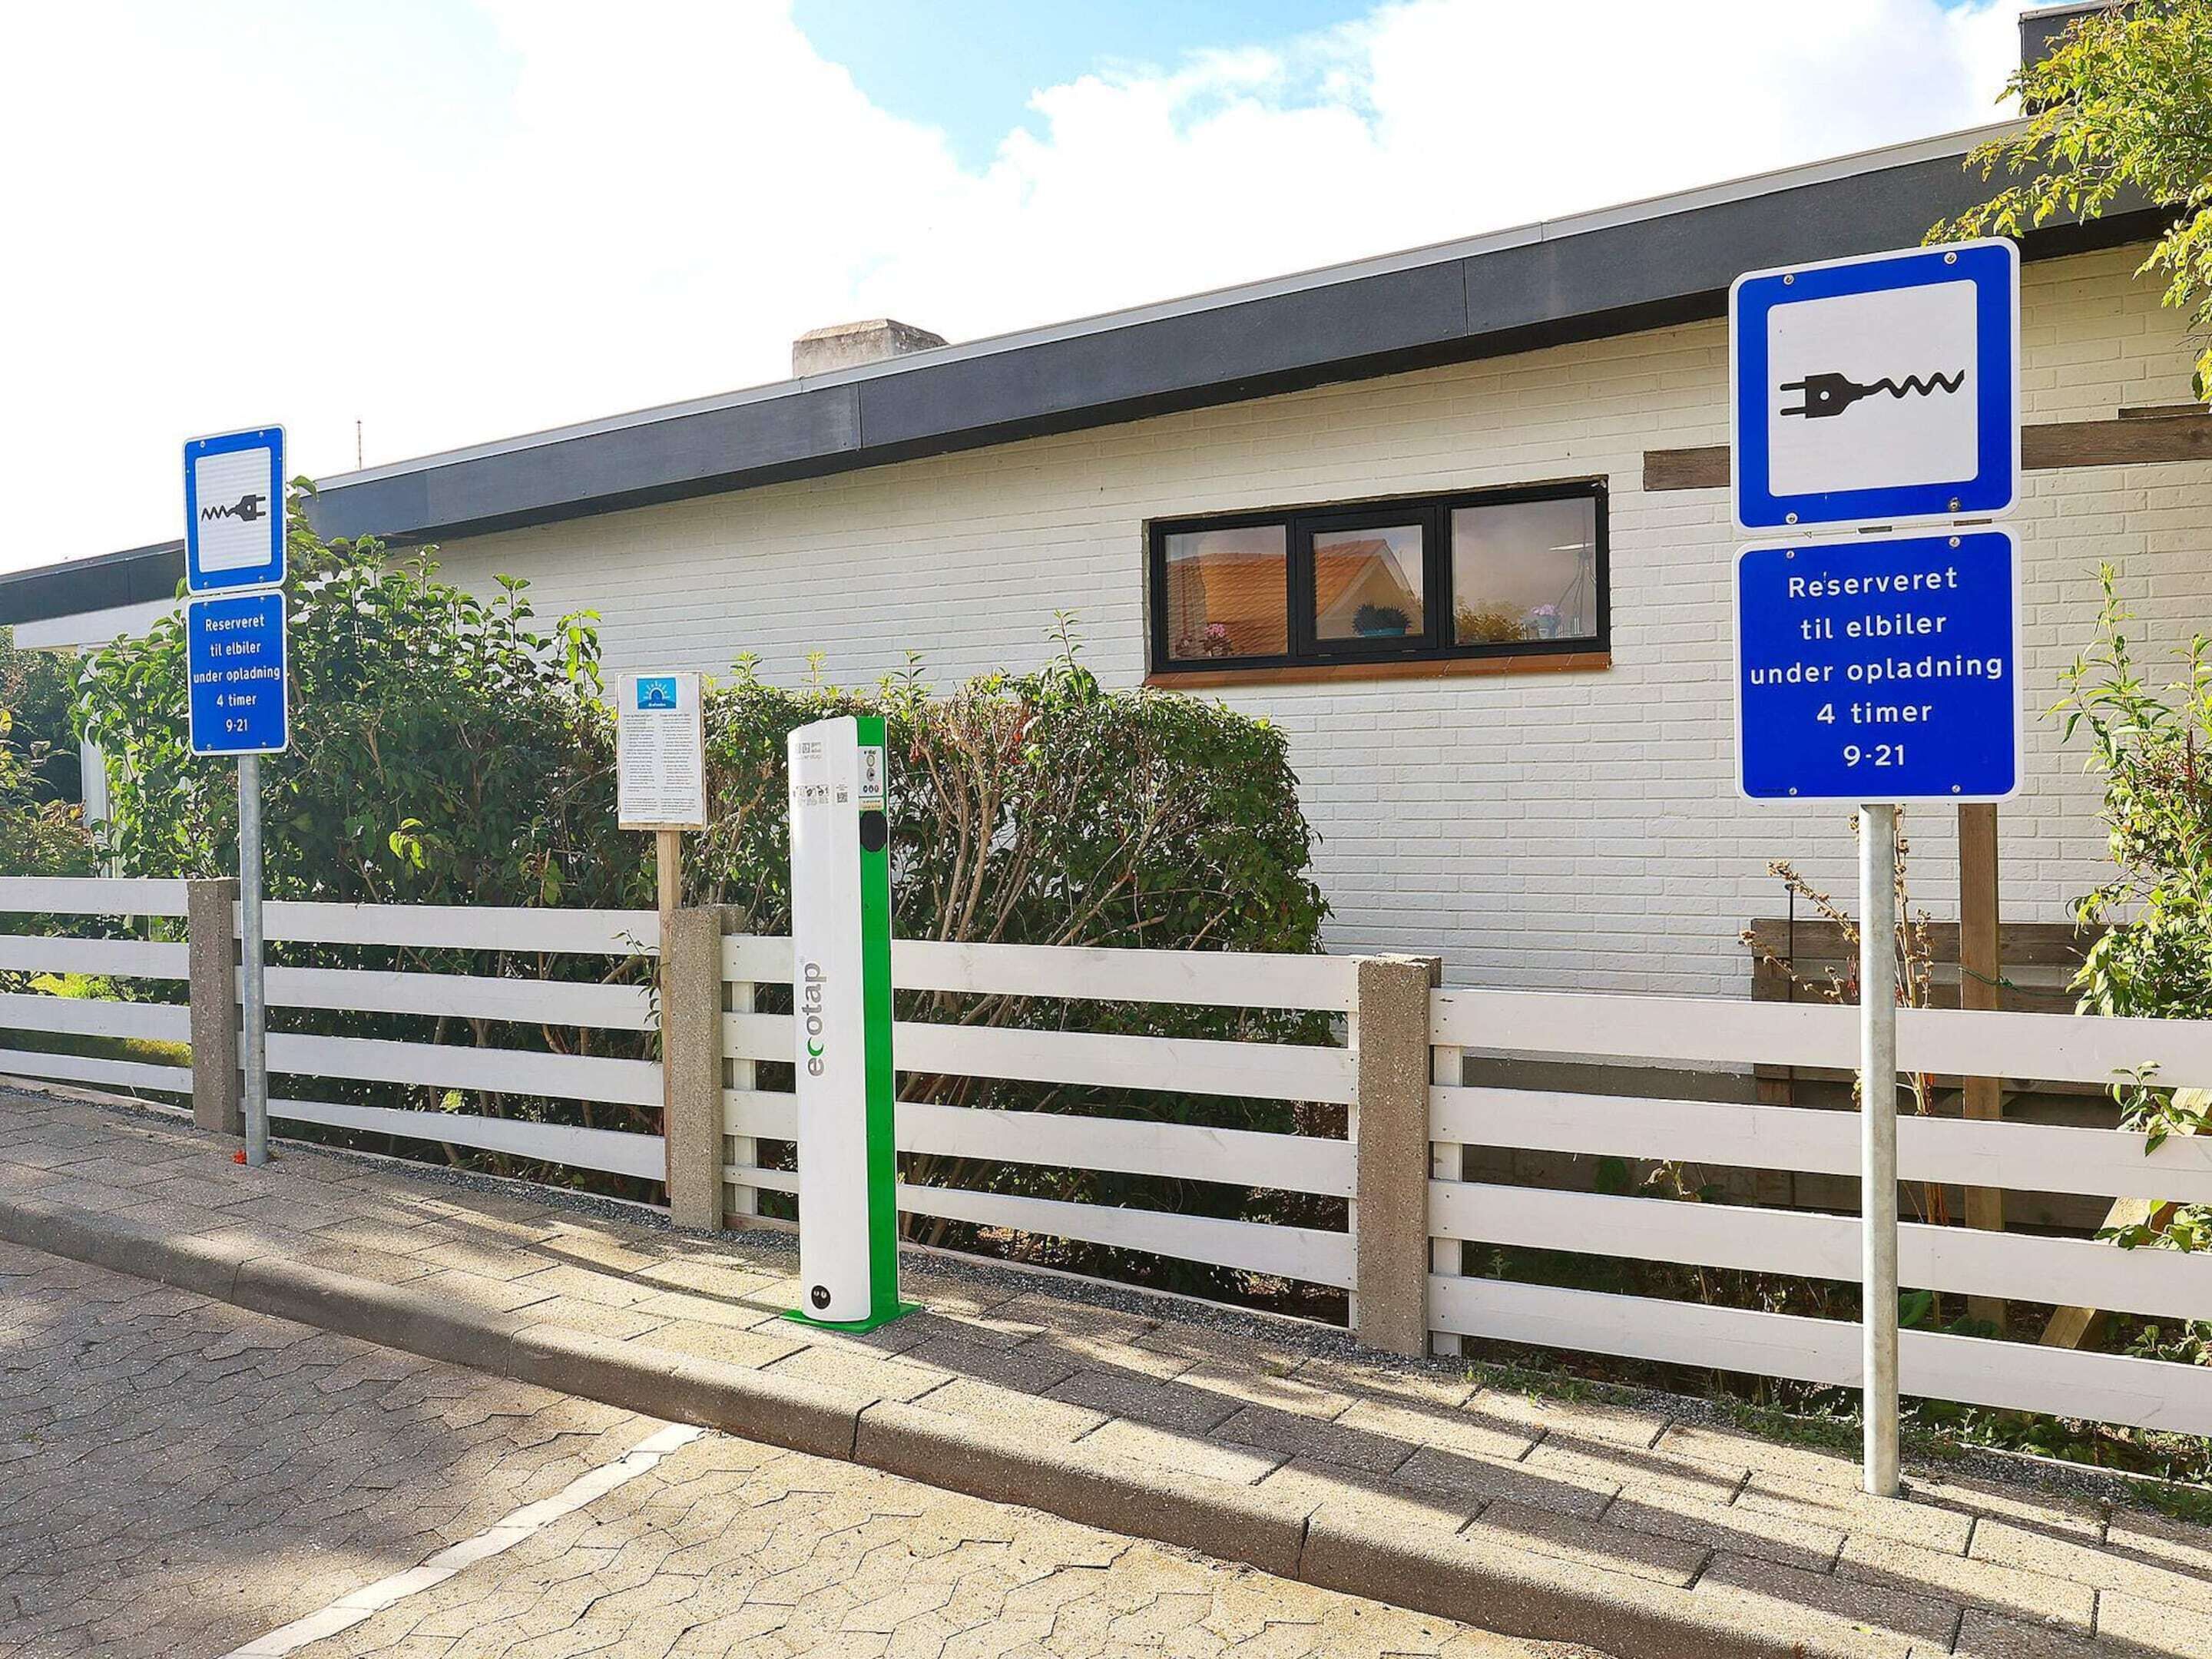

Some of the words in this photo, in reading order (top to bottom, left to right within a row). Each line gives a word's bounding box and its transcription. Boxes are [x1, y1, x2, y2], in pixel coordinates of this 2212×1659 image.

[1789, 567, 1958, 598] Reserveret
[205, 614, 264, 631] Reserveret
[1800, 618, 1833, 640] til
[1846, 613, 1946, 638] elbiler
[210, 644, 222, 657] til
[226, 642, 261, 655] elbiler
[194, 670, 222, 683] under
[226, 667, 280, 682] opladning
[1750, 661, 1834, 684] under
[1846, 654, 2002, 684] opladning
[216, 694, 224, 707] 4
[228, 693, 257, 706] timer
[1816, 704, 1836, 724] 4
[1850, 702, 1932, 724] timer
[226, 719, 247, 732] 9-21
[1843, 744, 1905, 767] 9-21
[802, 962, 827, 1077] ecotap
